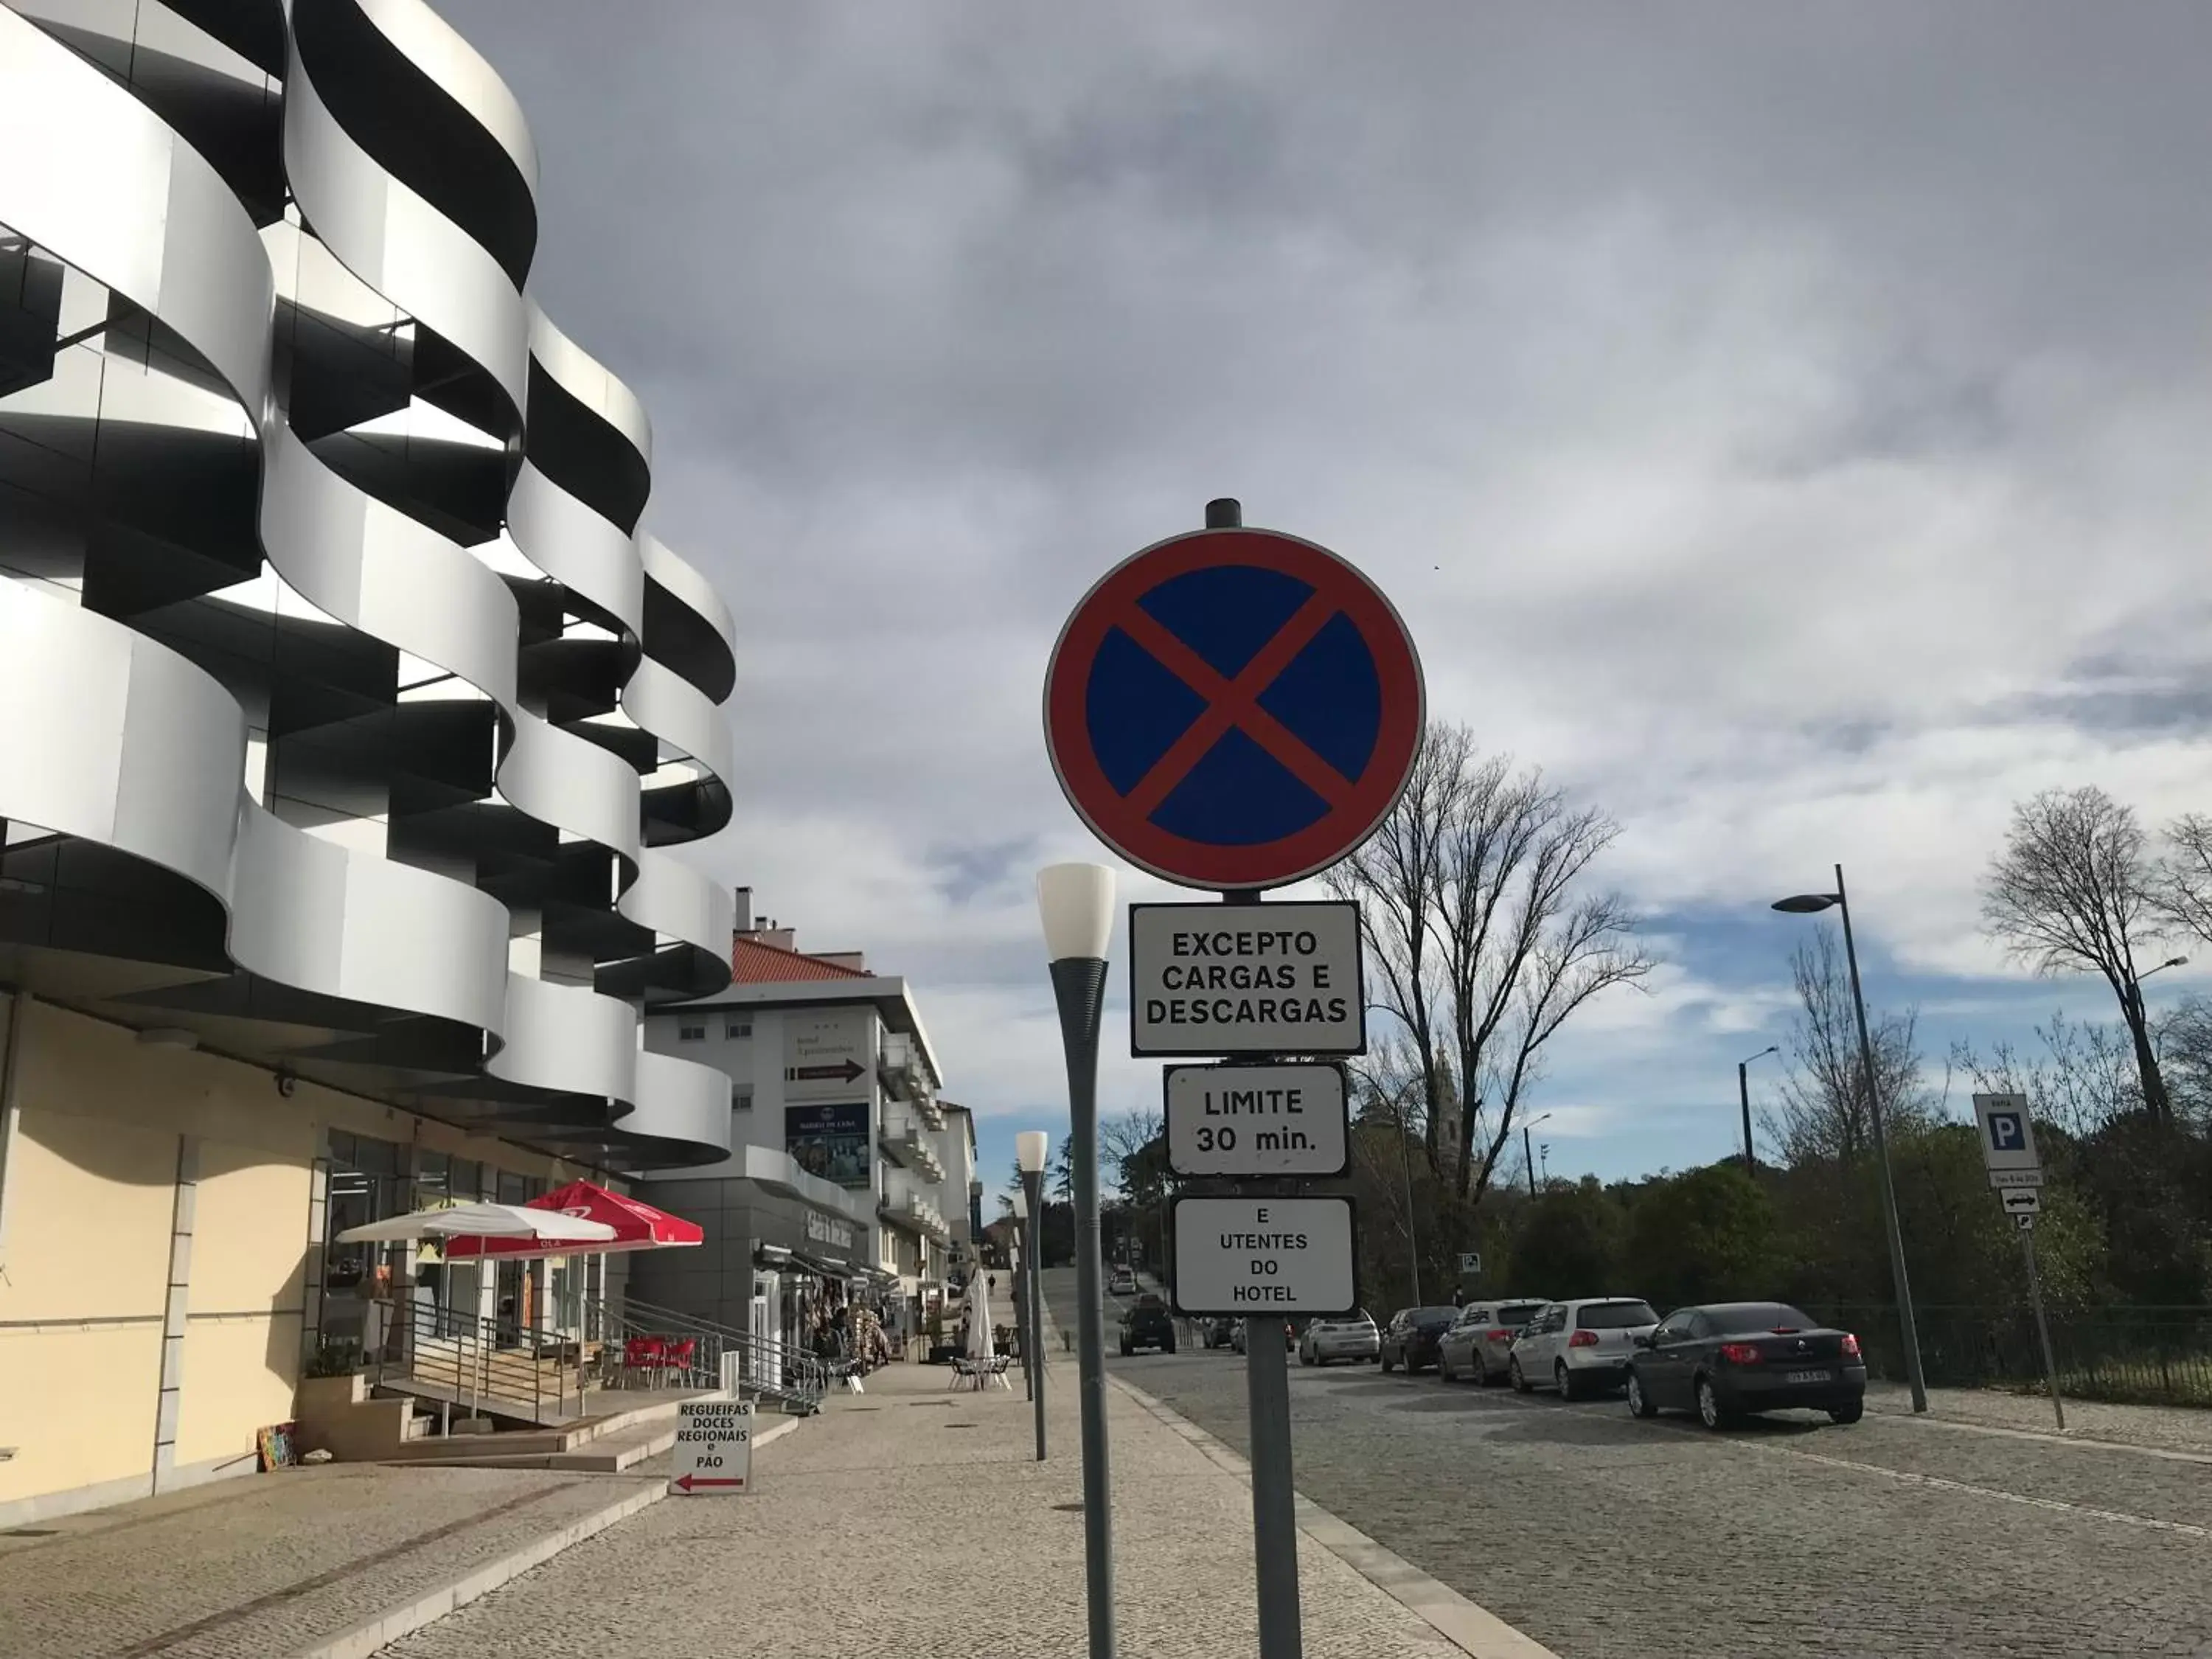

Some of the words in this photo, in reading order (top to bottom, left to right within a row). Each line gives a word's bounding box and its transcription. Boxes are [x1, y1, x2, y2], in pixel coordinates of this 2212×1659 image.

[1172, 931, 1317, 956] EXCEPTO
[1161, 964, 1296, 990] CARGAS
[1312, 964, 1330, 989] E
[1147, 998, 1347, 1024] DESCARGAS
[1205, 1088, 1304, 1116] LIMITE
[1196, 1127, 1237, 1152] 30
[1256, 1125, 1316, 1151] min.
[1257, 1208, 1269, 1223] E
[1220, 1234, 1308, 1250] UTENTES
[1251, 1259, 1278, 1275] DO
[1234, 1285, 1297, 1302] HOTEL
[681, 1404, 749, 1416] REGUEIFAS
[692, 1417, 734, 1429] DOCES
[678, 1430, 747, 1442] REGIONAIS
[696, 1454, 723, 1468] PÃO
